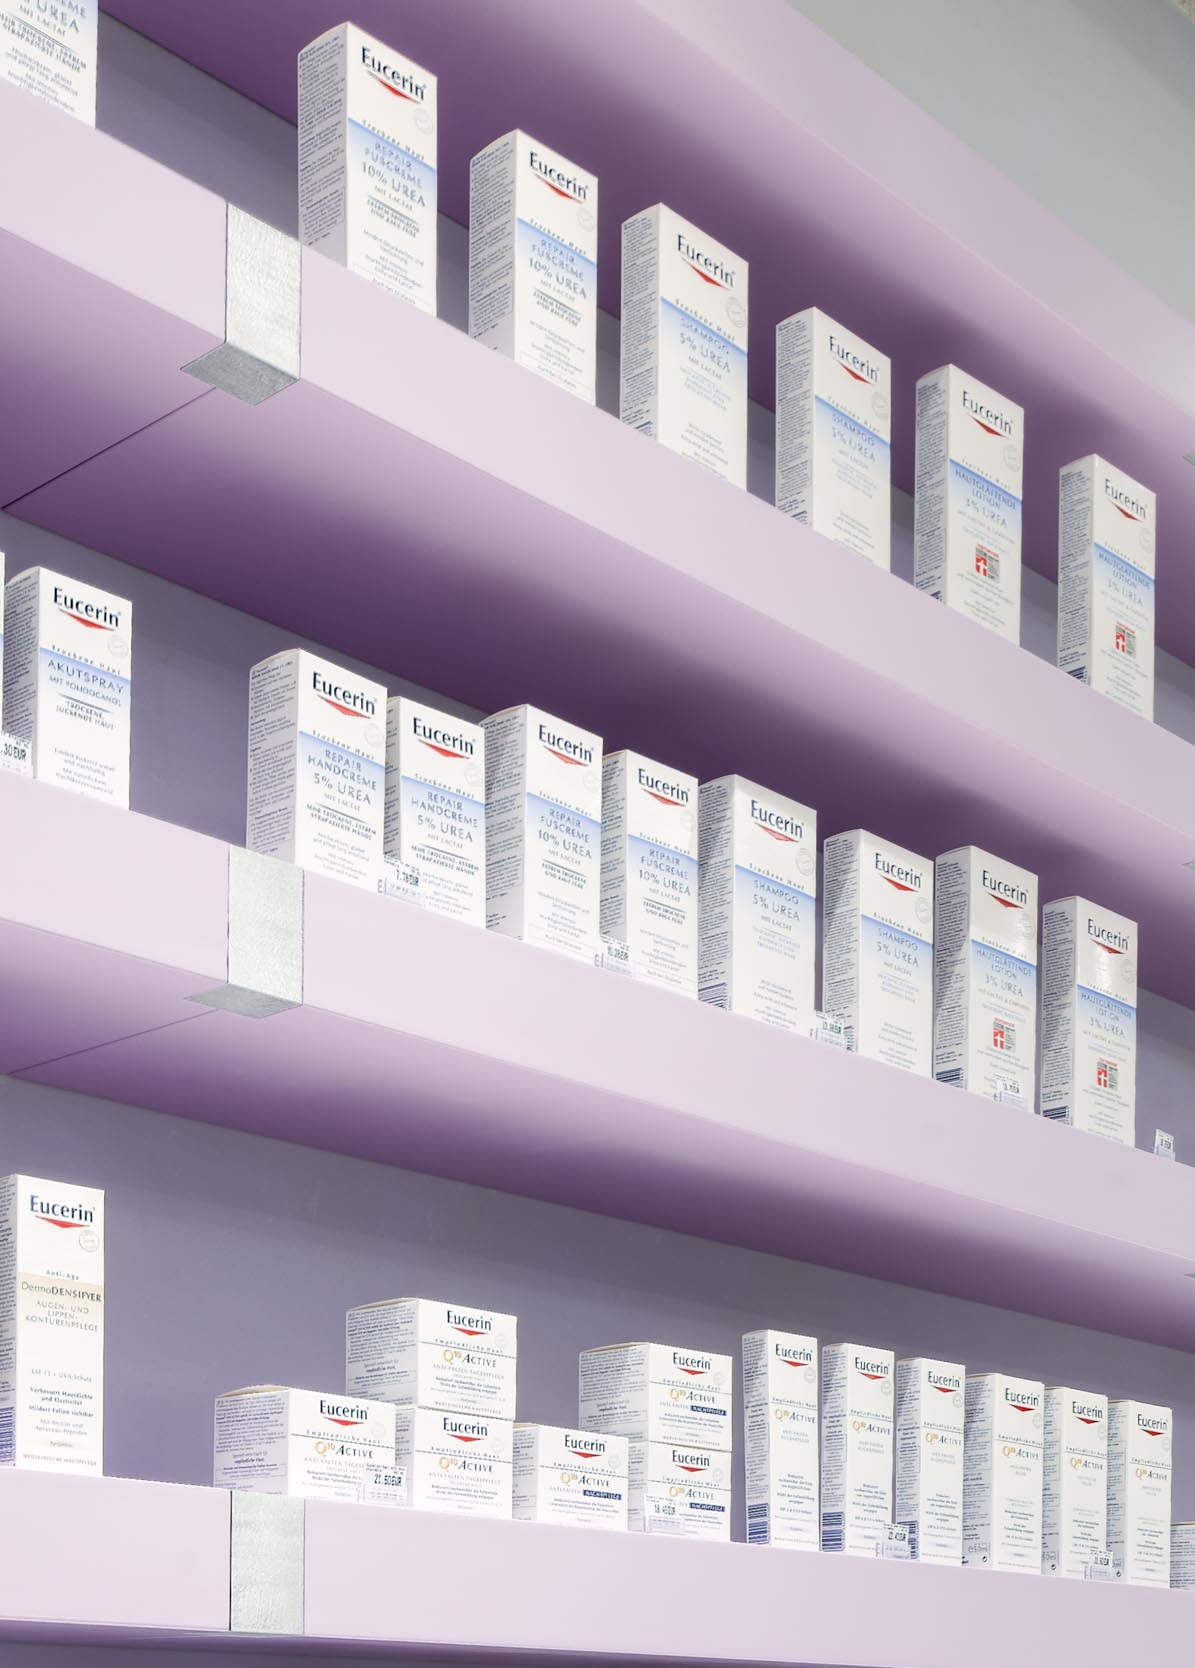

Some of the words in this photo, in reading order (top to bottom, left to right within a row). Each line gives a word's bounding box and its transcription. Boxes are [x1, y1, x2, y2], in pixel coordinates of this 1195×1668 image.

[361, 46, 425, 101] Eucerin
[361, 161, 388, 186] 10%
[391, 180, 426, 208] UREA
[530, 151, 588, 200] Eucerin
[677, 234, 735, 287] Eucerin
[529, 258, 552, 278] 10%
[556, 273, 587, 299] UREA
[700, 345, 731, 374] UREA
[829, 335, 879, 382] Eucerin
[962, 390, 1013, 435] Eucerin
[1105, 478, 1149, 517] Eucerin
[54, 587, 119, 627] Eucerin
[47, 659, 124, 693] AKUTSPRAY
[312, 671, 375, 715] Eucerin
[413, 717, 475, 755] Eucerin
[538, 724, 593, 764] Eucerin
[308, 755, 377, 791] HANDCREME
[325, 749, 362, 772] REPAIR
[314, 773, 333, 791] 5%
[337, 783, 372, 804] UREA
[638, 768, 690, 803] Eucerin
[411, 798, 478, 828] HANDCREME
[428, 792, 463, 811] REPAIR
[417, 815, 436, 831] 5%
[440, 823, 473, 842] UREA
[550, 808, 581, 828] REPAIR
[751, 800, 803, 839] Eucerin
[538, 830, 560, 847] 10%
[563, 839, 592, 860] UREA
[649, 849, 680, 866] REPAIR
[639, 870, 660, 886] 10%
[663, 877, 691, 896] UREA
[875, 853, 922, 889] Eucerin
[753, 880, 799, 905] SHAMPOO
[982, 869, 1028, 905] Eucerin
[753, 894, 769, 910] 5%
[772, 902, 800, 921] UREA
[878, 928, 919, 952] SHAMPOO
[1087, 918, 1130, 951] Eucerin
[894, 947, 919, 967] UREA
[1001, 979, 1023, 997] UREA
[1104, 1020, 1125, 1037] UREA
[29, 1195, 94, 1223] Eucerin
[21, 1281, 102, 1302] DermoDENSIFYER
[70, 1305, 89, 1314] UND
[446, 1310, 492, 1331] Eucerin
[672, 1352, 712, 1371] Eucerin
[775, 1344, 813, 1361] Eucerin
[855, 1357, 890, 1375] Eucerin
[928, 1370, 960, 1389] Eucerin
[319, 1399, 369, 1421] Eucerin
[1005, 1388, 1040, 1406] Eucerin
[1072, 1400, 1103, 1419] Eucerin
[443, 1417, 489, 1436] Eucerin
[1137, 1412, 1168, 1430] Eucerin
[564, 1435, 606, 1453] Eucerin
[672, 1450, 710, 1467] Eucerin
